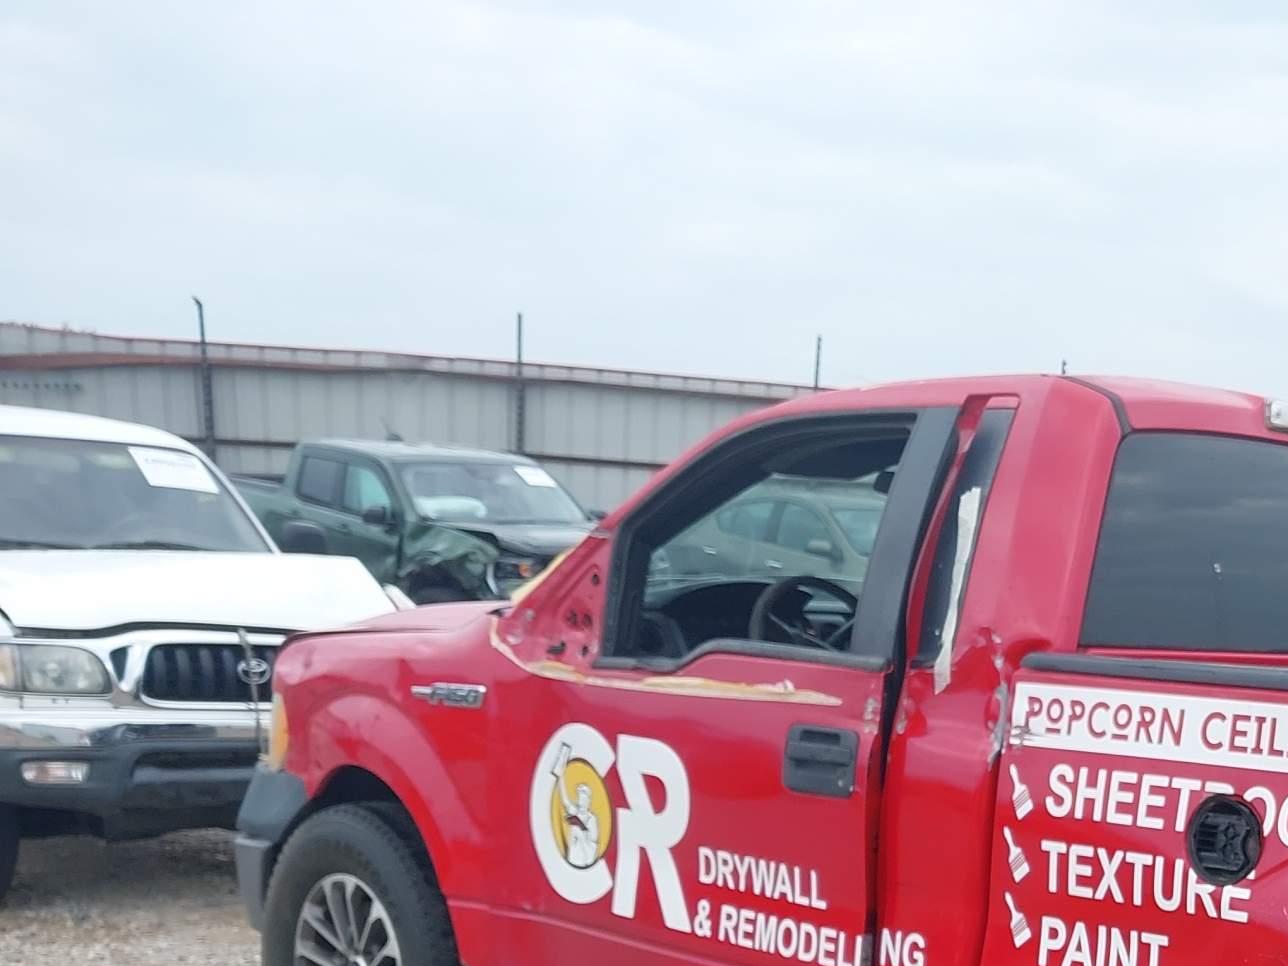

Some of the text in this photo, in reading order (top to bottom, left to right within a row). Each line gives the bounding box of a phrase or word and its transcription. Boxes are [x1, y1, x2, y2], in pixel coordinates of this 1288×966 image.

[1025, 695, 1185, 748] POPCORN
[530, 721, 692, 933] CR
[698, 846, 828, 911] DRYWALL
[1040, 839, 1257, 924] TEXTURE
[693, 899, 712, 938] &
